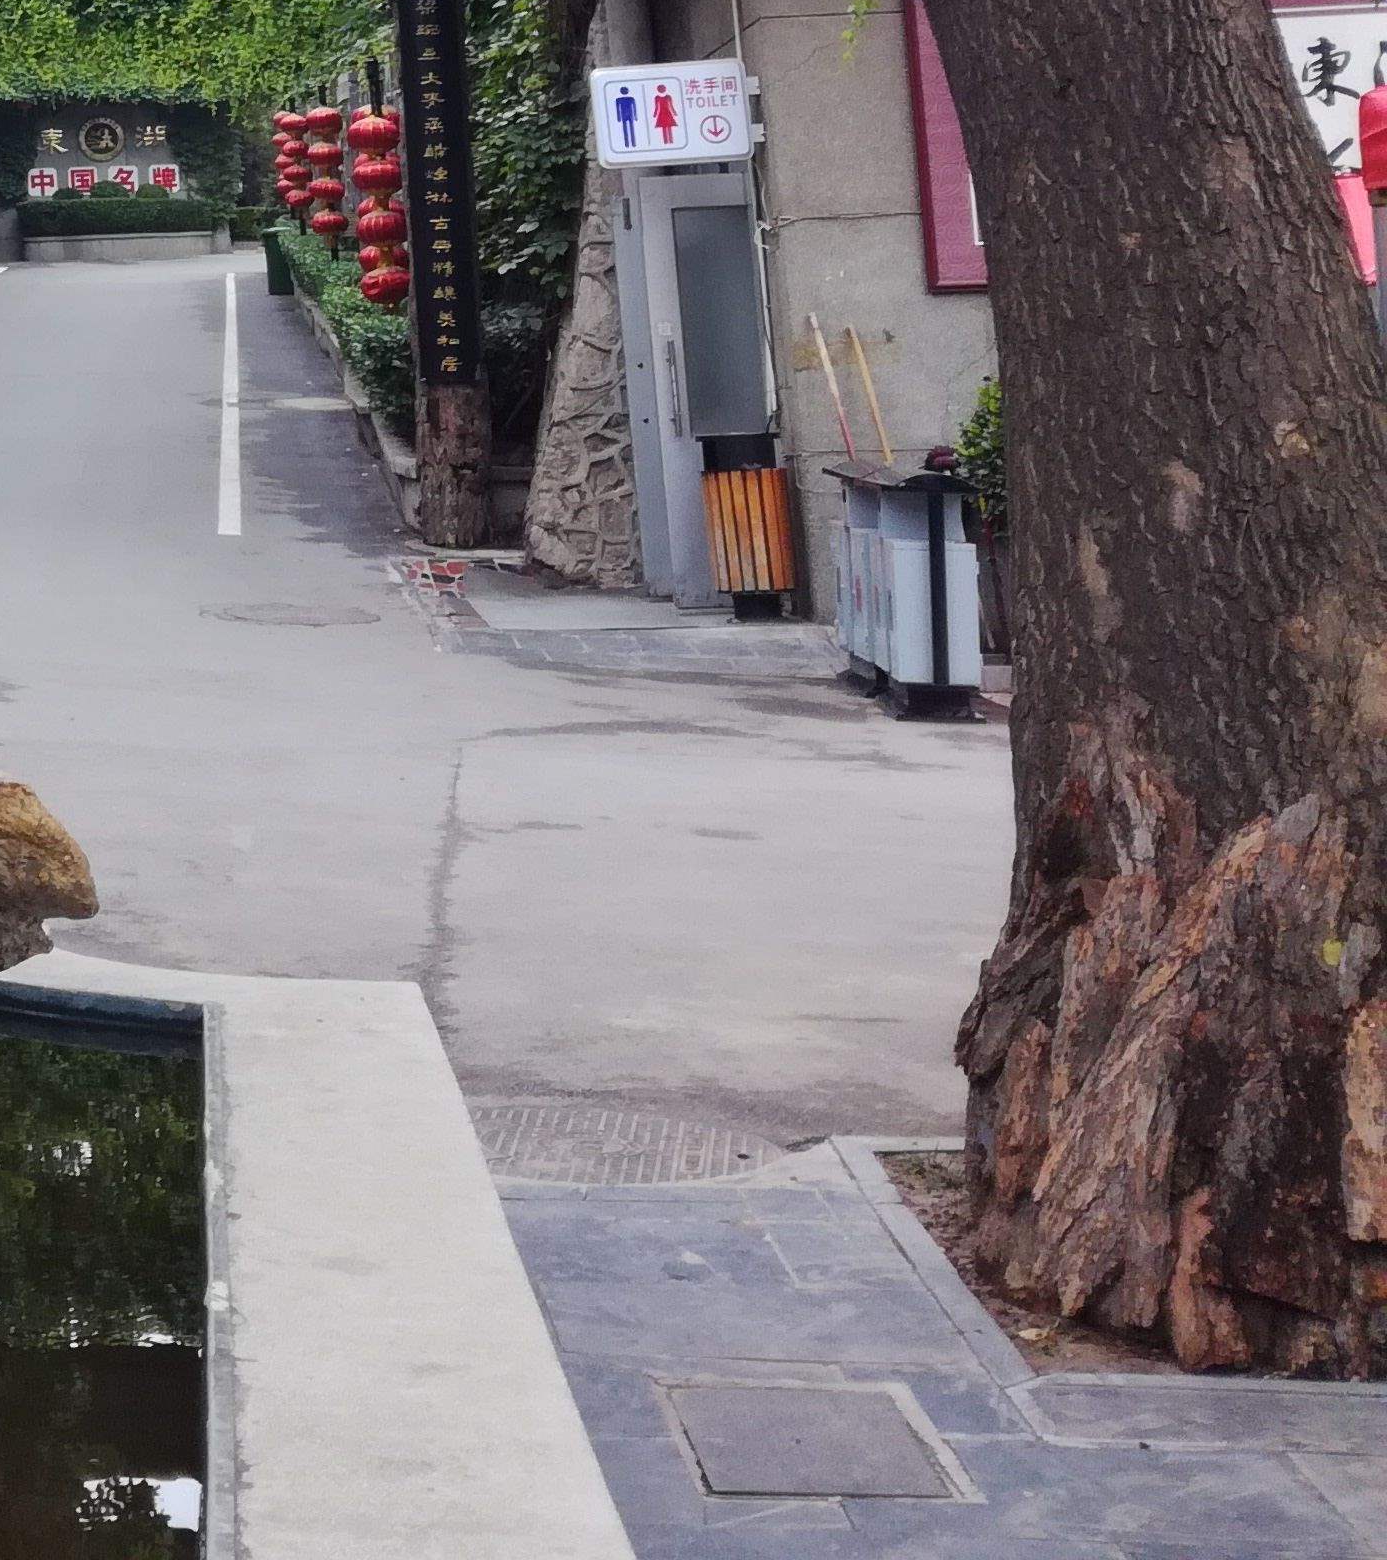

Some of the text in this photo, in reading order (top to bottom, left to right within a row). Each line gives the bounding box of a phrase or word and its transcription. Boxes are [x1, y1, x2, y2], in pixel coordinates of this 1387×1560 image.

[684, 76, 738, 95] 洗手间
[686, 94, 738, 109] TOILET
[30, 166, 178, 197] 中国名牌
